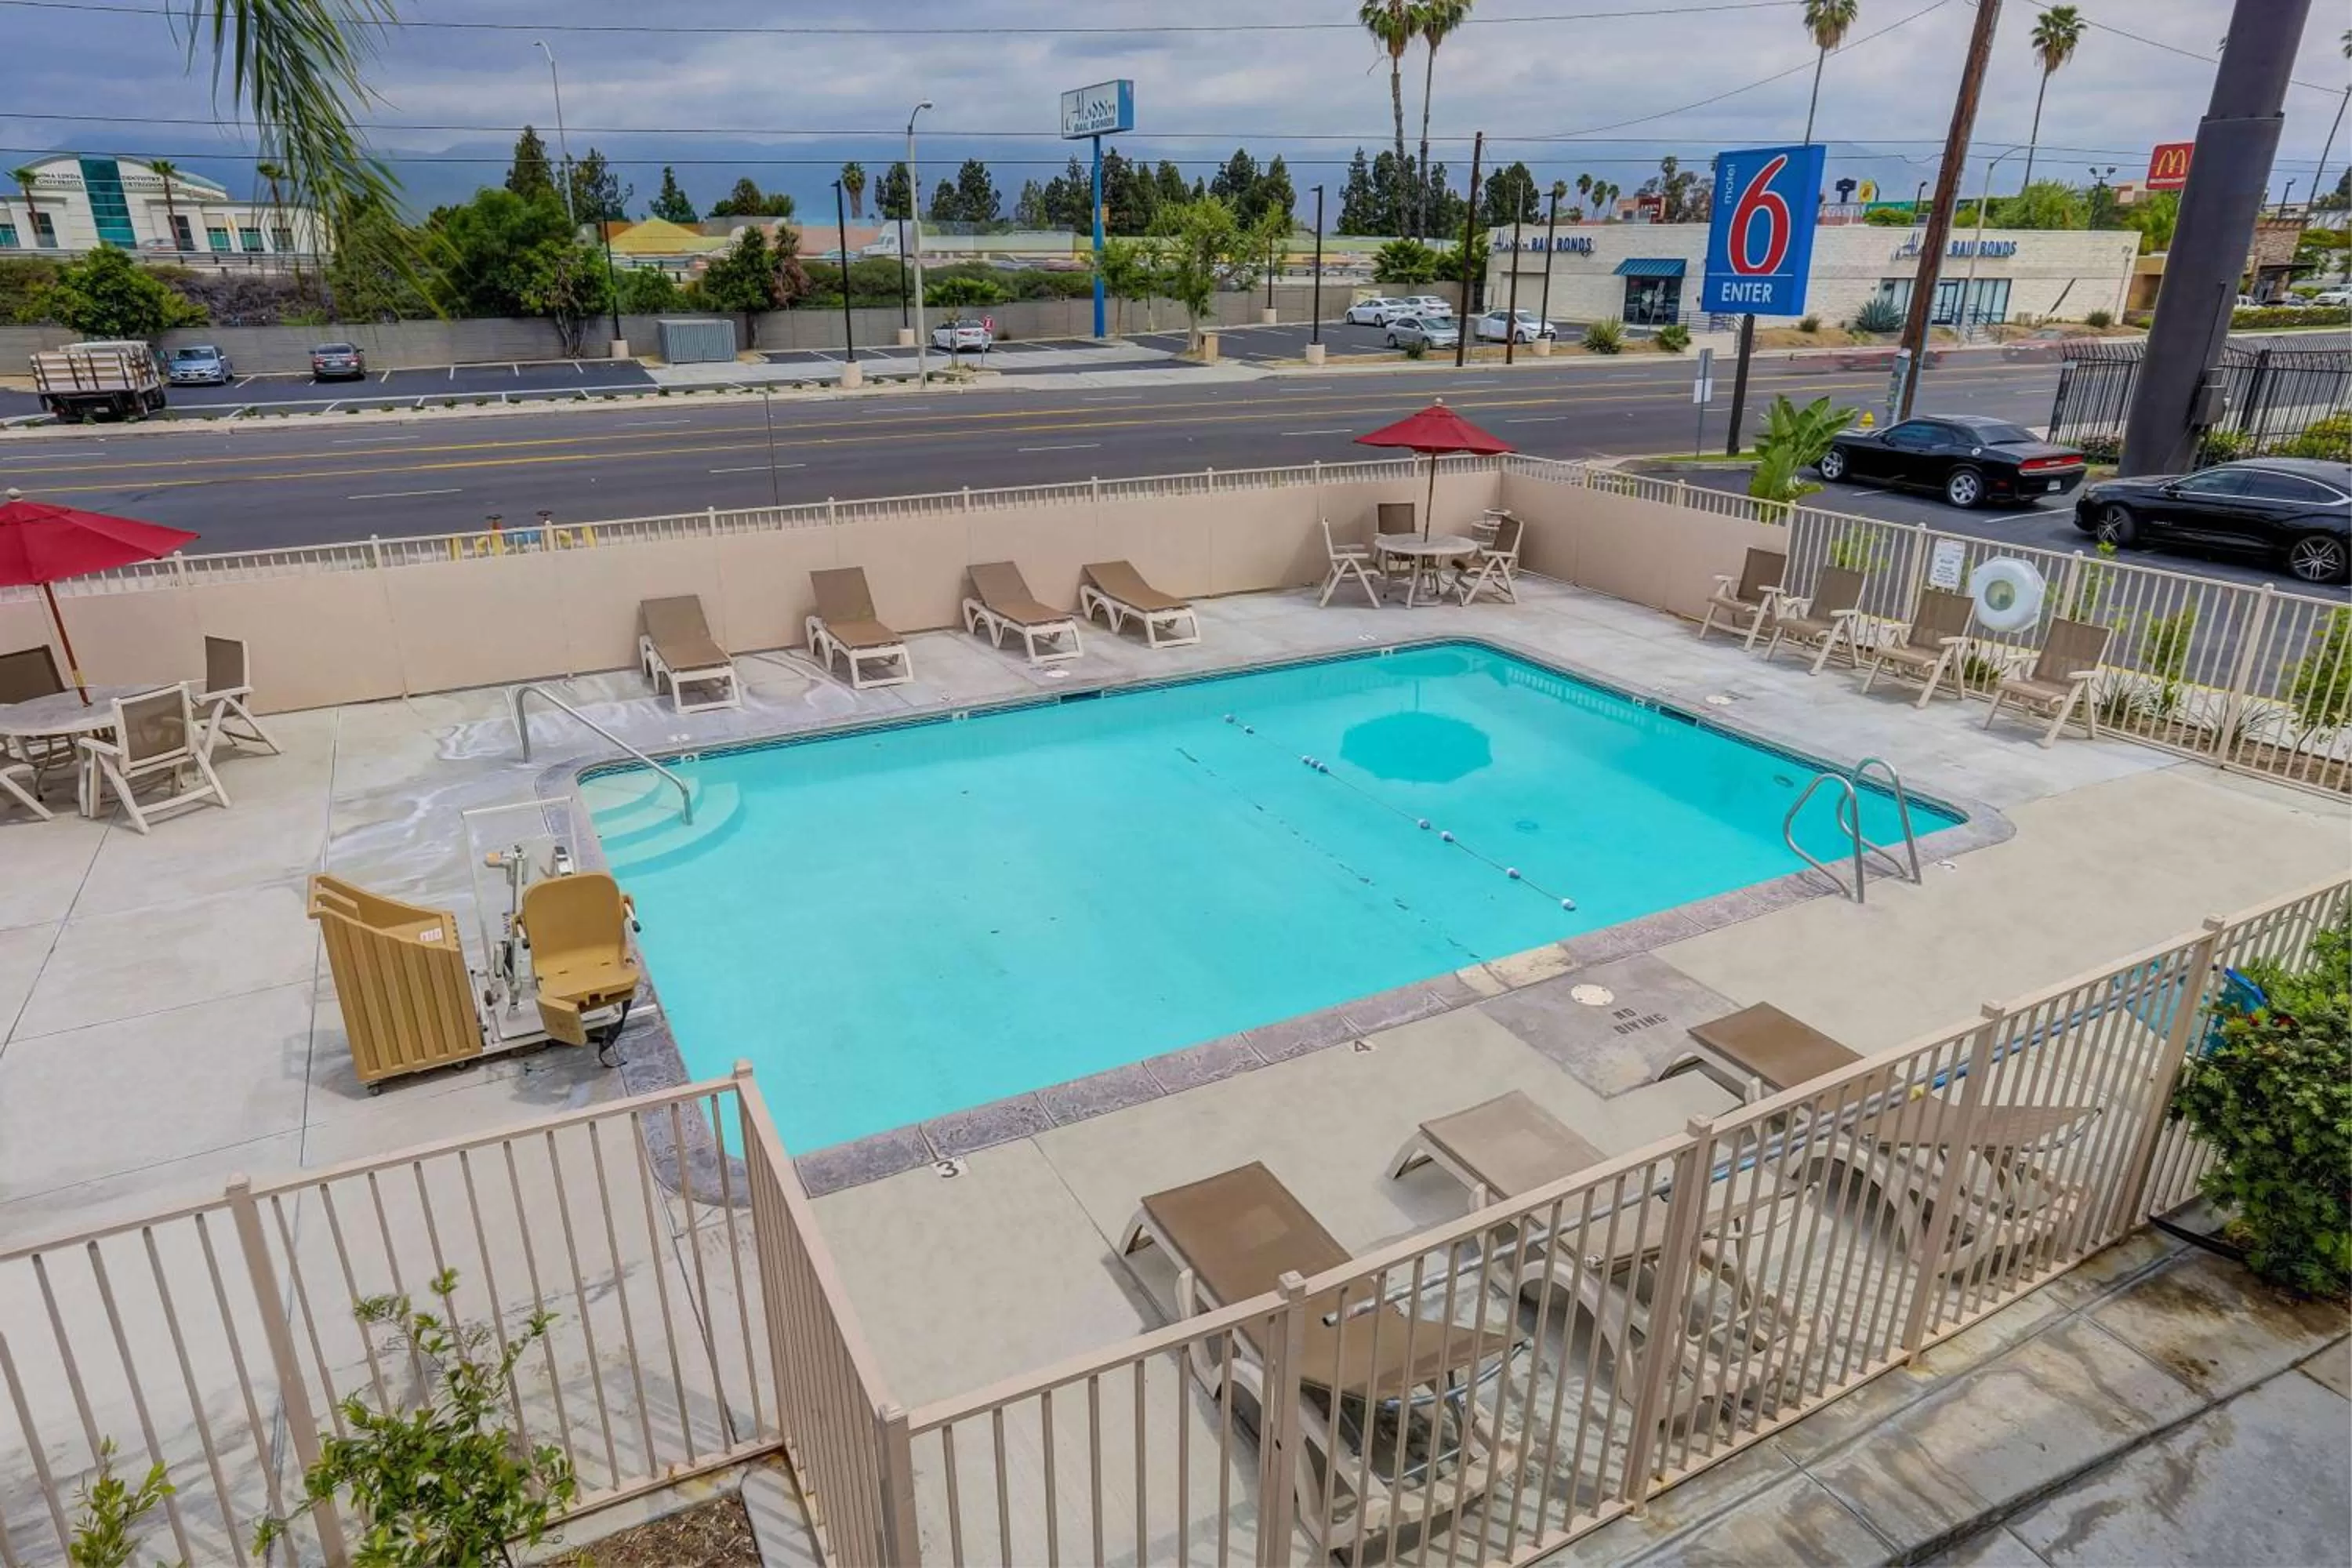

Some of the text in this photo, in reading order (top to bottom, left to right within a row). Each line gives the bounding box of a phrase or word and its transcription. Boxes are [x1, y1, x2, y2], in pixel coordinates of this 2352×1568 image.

[1725, 153, 1791, 276] motel 6
[1557, 237, 1593, 252] BONDS
[1980, 240, 2017, 256] BONDS
[1721, 281, 1773, 303] ENTER
[1612, 1007, 1637, 1020] NO
[1613, 1013, 1668, 1034] DIVING
[1354, 1040, 1373, 1052] 4
[936, 1160, 959, 1178] 3
